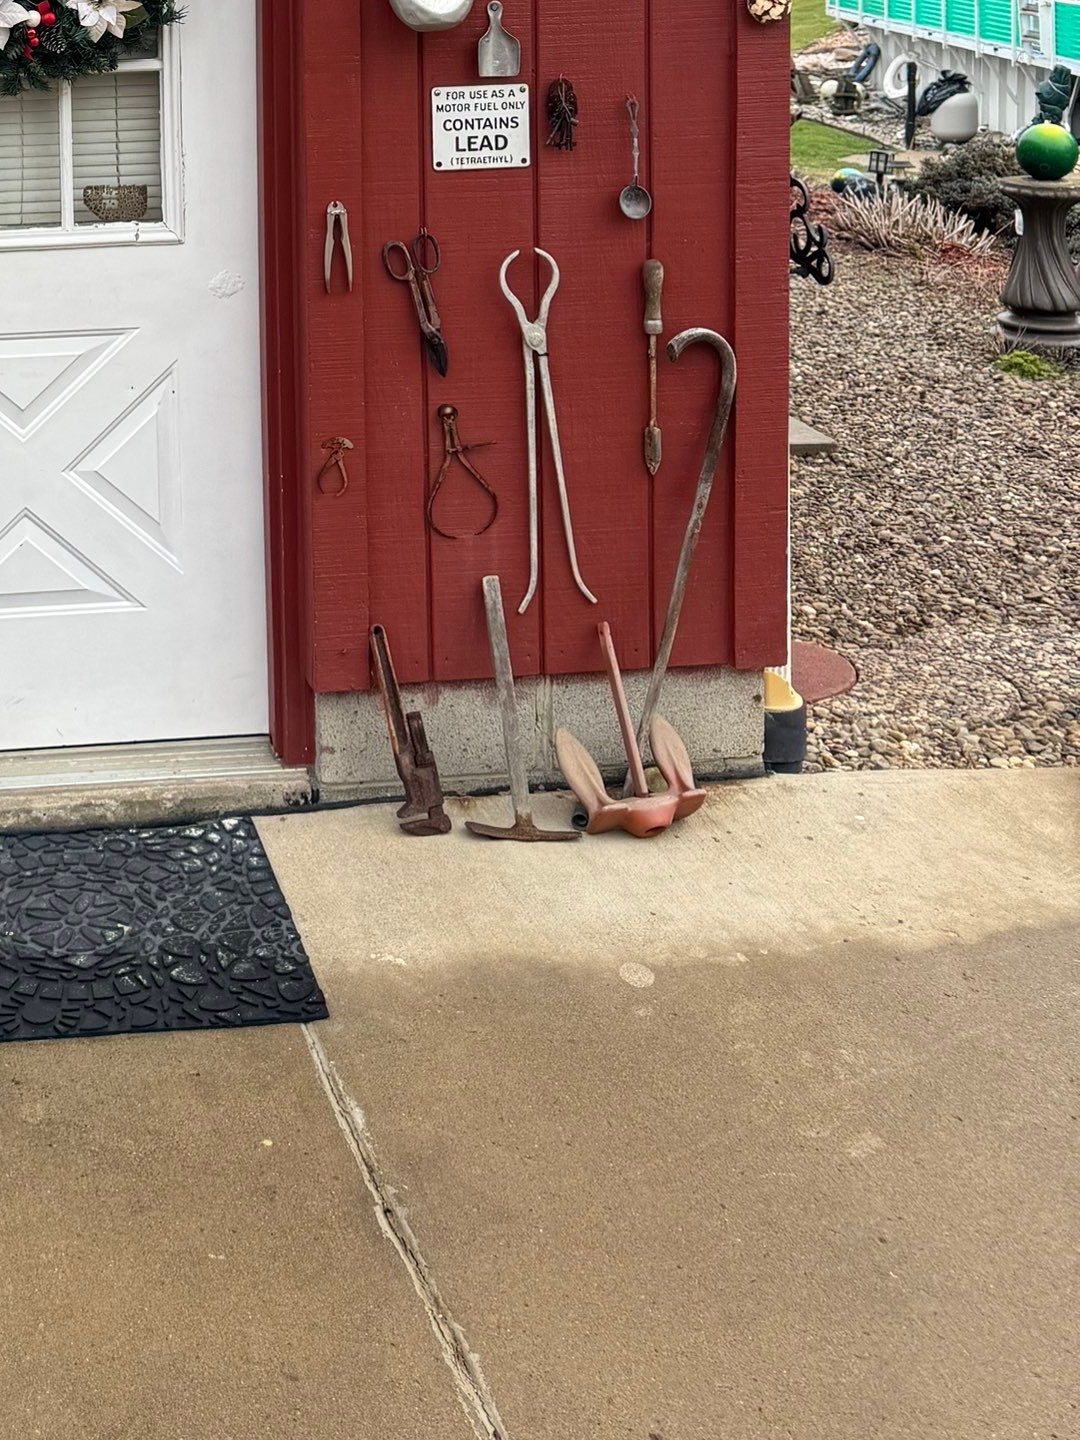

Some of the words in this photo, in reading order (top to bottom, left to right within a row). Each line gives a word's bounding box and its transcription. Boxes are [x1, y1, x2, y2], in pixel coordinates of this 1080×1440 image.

[446, 91, 465, 100] FOR
[469, 89, 488, 100] USE
[491, 89, 505, 98] AS
[508, 89, 516, 98] A
[436, 103, 471, 113] MOTOR
[474, 101, 499, 111] FUEL
[501, 100, 526, 110] ONLY
[443, 116, 519, 131] CONTAINS
[455, 134, 509, 152] LEAD
[450, 154, 513, 166] (TETRAETHYL)
